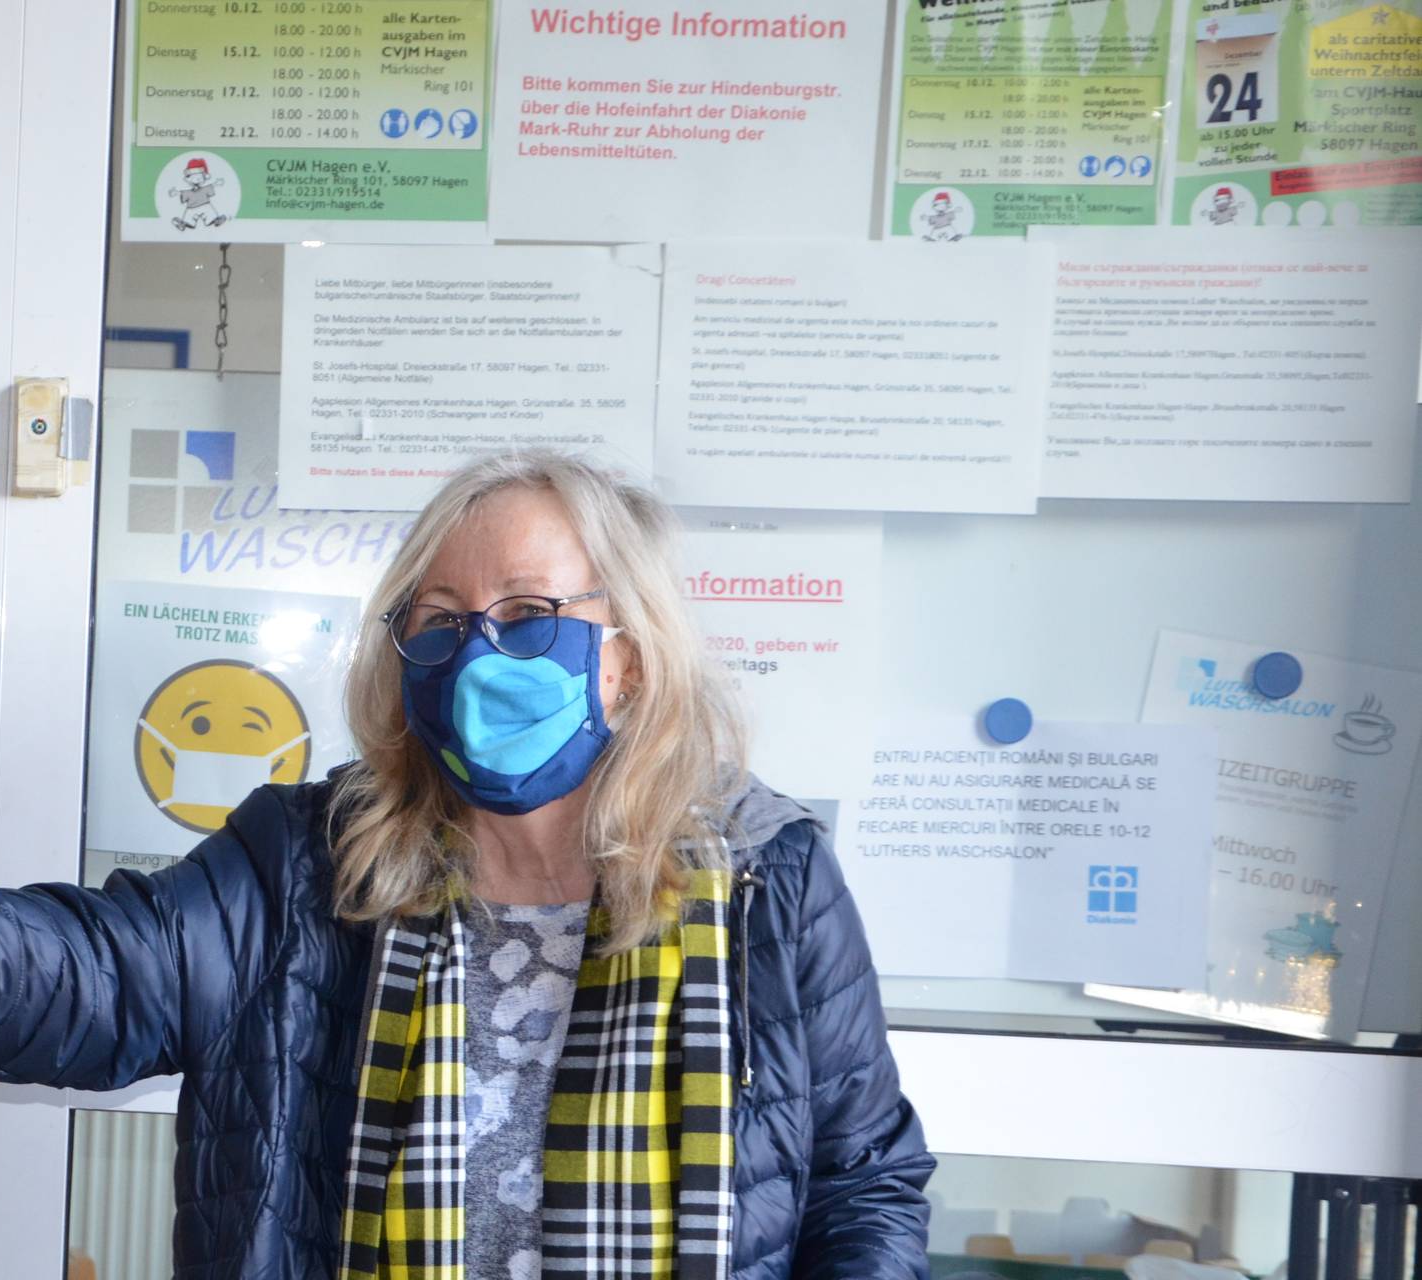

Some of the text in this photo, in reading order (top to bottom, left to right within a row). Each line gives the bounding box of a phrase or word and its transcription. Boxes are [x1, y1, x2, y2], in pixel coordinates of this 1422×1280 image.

[147, 2, 363, 16] Donnerstag 10.12. 10.00 12.00 h
[382, 12, 461, 24] alle Karten-
[530, 8, 847, 42] Wichtige Information
[274, 24, 362, 36] 18.00 20.00 h
[382, 30, 466, 44] ausgaben im
[1329, 33, 1348, 46] als
[146, 46, 361, 60] Dienstag 15.12. 10.00 12.00 h
[381, 46, 468, 60] CVJM Hagen
[1315, 48, 1422, 62] Weihnachtsfei
[273, 68, 360, 80] 18.00 20.00 h
[1310, 64, 1422, 78] unterm Zeltda
[146, 86, 360, 100] Donnerstag 17.12. 10.00 12.00 h
[424, 80, 474, 94] Ring 101
[522, 76, 843, 101] Bitte kommen Sie zur Hindenburgstr.
[1314, 88, 1338, 98] am
[1206, 72, 1263, 124] 24
[271, 108, 359, 120] 18.00 20.00 h
[521, 100, 808, 121] über die Hofeinfahrt der Diakonie
[1331, 104, 1412, 119] Sportplatz
[144, 126, 358, 140] Dienstag 22.12. 10.00 14.00 h
[518, 120, 764, 144] Mark-Ruhr zur Abholung der
[1218, 128, 1248, 140] 15.00
[1252, 126, 1276, 137] Uhr
[1294, 120, 1417, 137] Märkischer Ring
[518, 142, 678, 160] Lebensmitteltüten.
[1214, 142, 1262, 154] zu jeder
[1320, 138, 1418, 153] 58097 Hagen
[1236, 154, 1278, 165] Stunde
[266, 159, 392, 177] CVJM Hagen e.V.
[266, 174, 329, 186] Märkischer
[333, 174, 358, 189] Ring
[392, 176, 428, 186] 58097
[432, 176, 468, 188] Hagen
[266, 186, 381, 198] Tel.: 02331/919514
[266, 198, 384, 211] info@cvjm-hagen.de
[683, 571, 843, 596] nformation
[124, 603, 149, 618] EIN
[153, 602, 218, 624] LÄCHELN
[175, 625, 259, 645] TROTZ MAS
[754, 638, 807, 655] geben
[813, 640, 840, 652] wir
[1188, 690, 1336, 718] WASCHSALON
[874, 750, 920, 764] ENTRU
[1088, 752, 1158, 766] BULGARI
[872, 774, 899, 786] ARE
[904, 774, 924, 787] NU
[929, 774, 950, 787] AU
[954, 775, 1043, 788] ASIGURARE
[1136, 778, 1157, 790] SE
[1215, 758, 1358, 799] IZEITGRUPPE
[1018, 799, 1098, 813] MEDICALE
[858, 820, 920, 834] FIECARE
[923, 821, 996, 834] MIERCURI
[1050, 822, 1103, 836] ORELE
[1109, 824, 1151, 838] 10-12
[1211, 834, 1298, 865] Mittwoch
[114, 852, 164, 868] Leitung:
[1238, 866, 1340, 897] 16.00 Uhr
[1086, 914, 1138, 926] Diakonie
